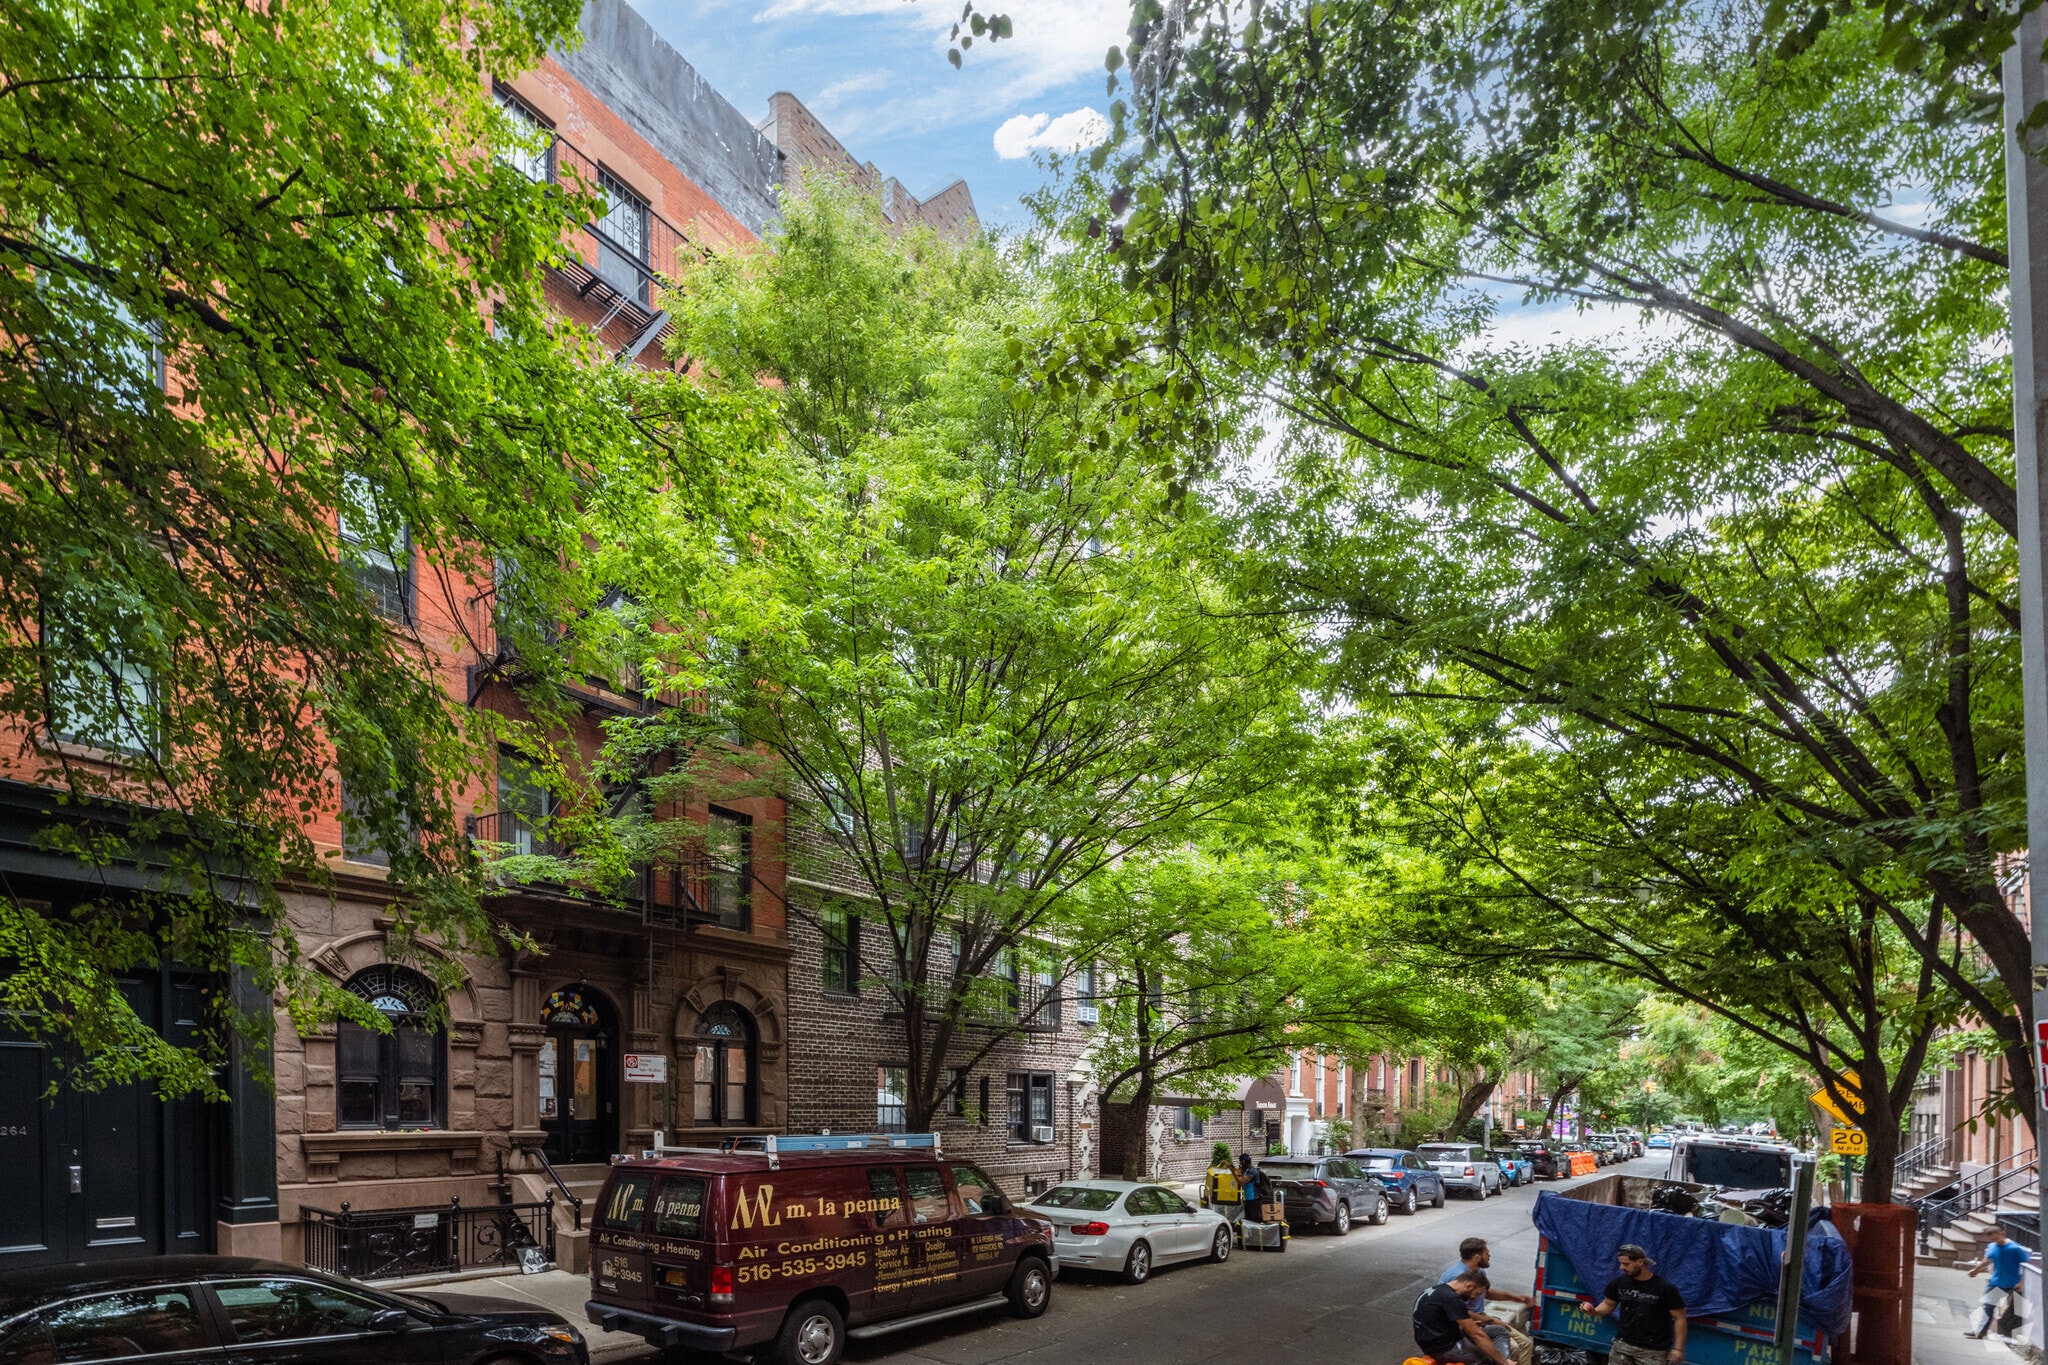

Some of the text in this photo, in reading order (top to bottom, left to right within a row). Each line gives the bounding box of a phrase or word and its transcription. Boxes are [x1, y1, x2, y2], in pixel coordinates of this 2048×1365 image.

[0, 1126, 27, 1136] 264
[1834, 1132, 1863, 1145] 20
[654, 1195, 665, 1213] la
[666, 1201, 701, 1218] penna
[786, 1196, 901, 1219] m. la penna
[600, 1232, 610, 1244] Air
[666, 1242, 701, 1260] Heating
[738, 1225, 952, 1260] Air Conditioning Hating
[900, 1244, 910, 1255] Air
[925, 1239, 946, 1252] Quality
[614, 1256, 629, 1269] 516
[737, 1251, 867, 1284] 516-535-3945
[878, 1257, 902, 1270] Service
[611, 1267, 643, 1283] 5-3945
[1749, 1304, 1776, 1320] NO
[1567, 1318, 1596, 1336] ING
